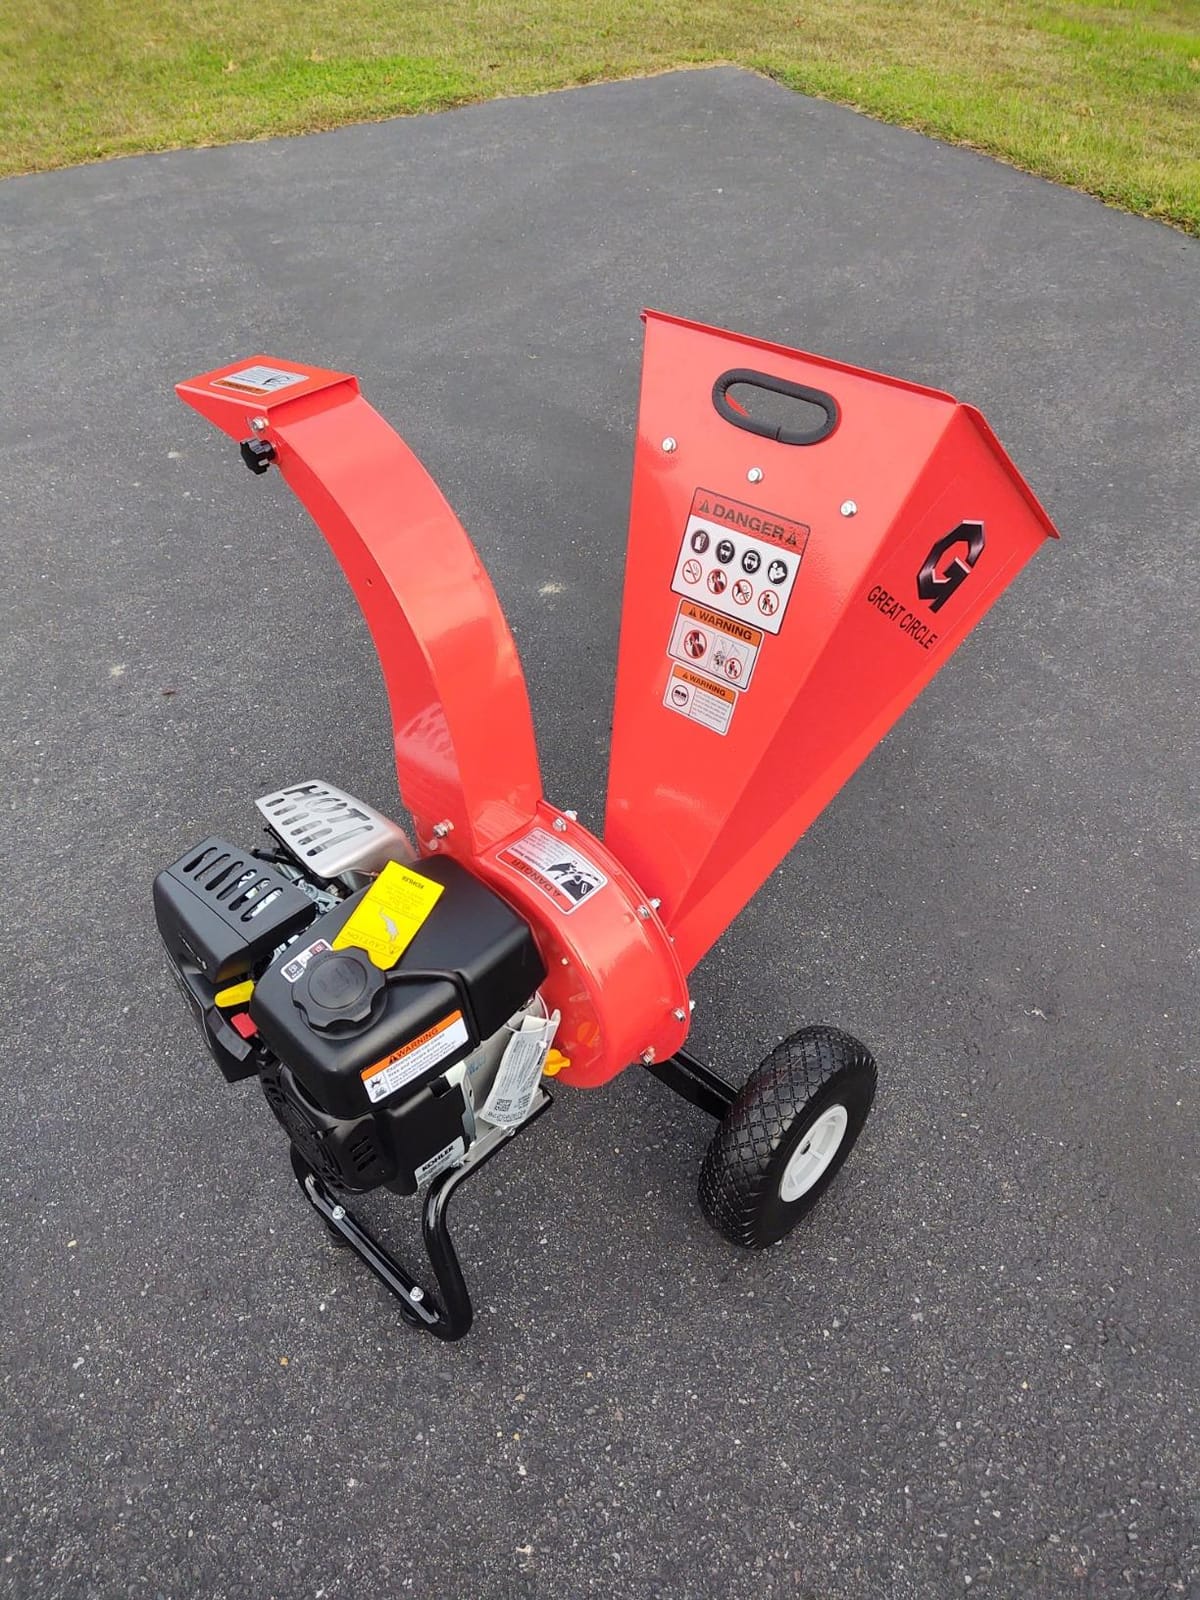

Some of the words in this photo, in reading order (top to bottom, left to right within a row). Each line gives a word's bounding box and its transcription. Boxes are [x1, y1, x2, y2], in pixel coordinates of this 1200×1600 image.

[713, 503, 786, 541] DANGER
[699, 610, 753, 641] WARNING
[867, 585, 906, 622] GREAT
[899, 613, 938, 650] CIRCLE
[689, 675, 727, 698] WARNING
[283, 785, 371, 824] HOT
[511, 859, 554, 892] DANGER
[397, 1027, 440, 1058] WARNING
[422, 1145, 454, 1171] KOHLER
